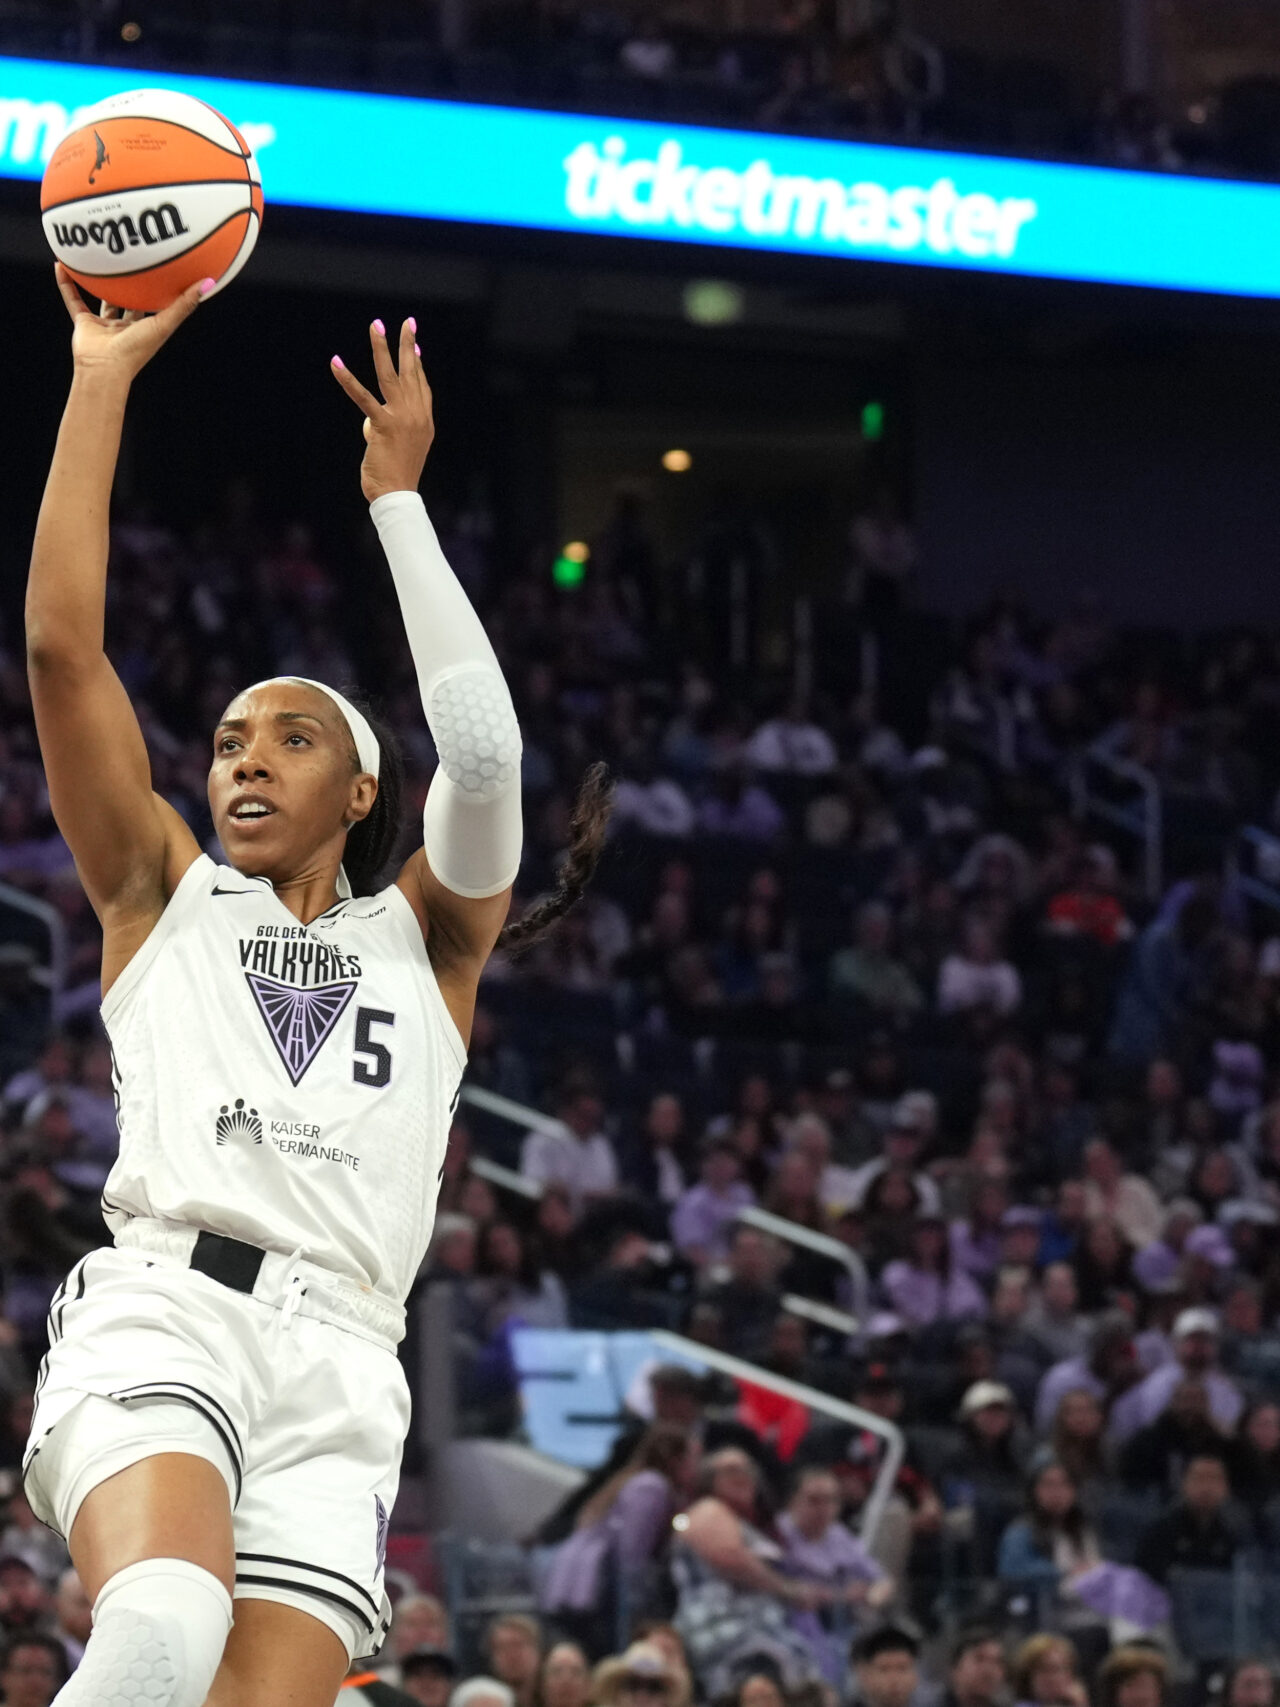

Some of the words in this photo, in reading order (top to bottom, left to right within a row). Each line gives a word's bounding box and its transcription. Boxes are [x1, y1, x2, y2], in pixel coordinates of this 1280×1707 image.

[564, 136, 1037, 259] ticketmaster
[53, 203, 189, 254] Wilson
[256, 925, 308, 939] GOLDEN
[238, 939, 363, 987] VALKYRIES
[352, 1005, 396, 1090] 5
[270, 1120, 321, 1139] KAISER
